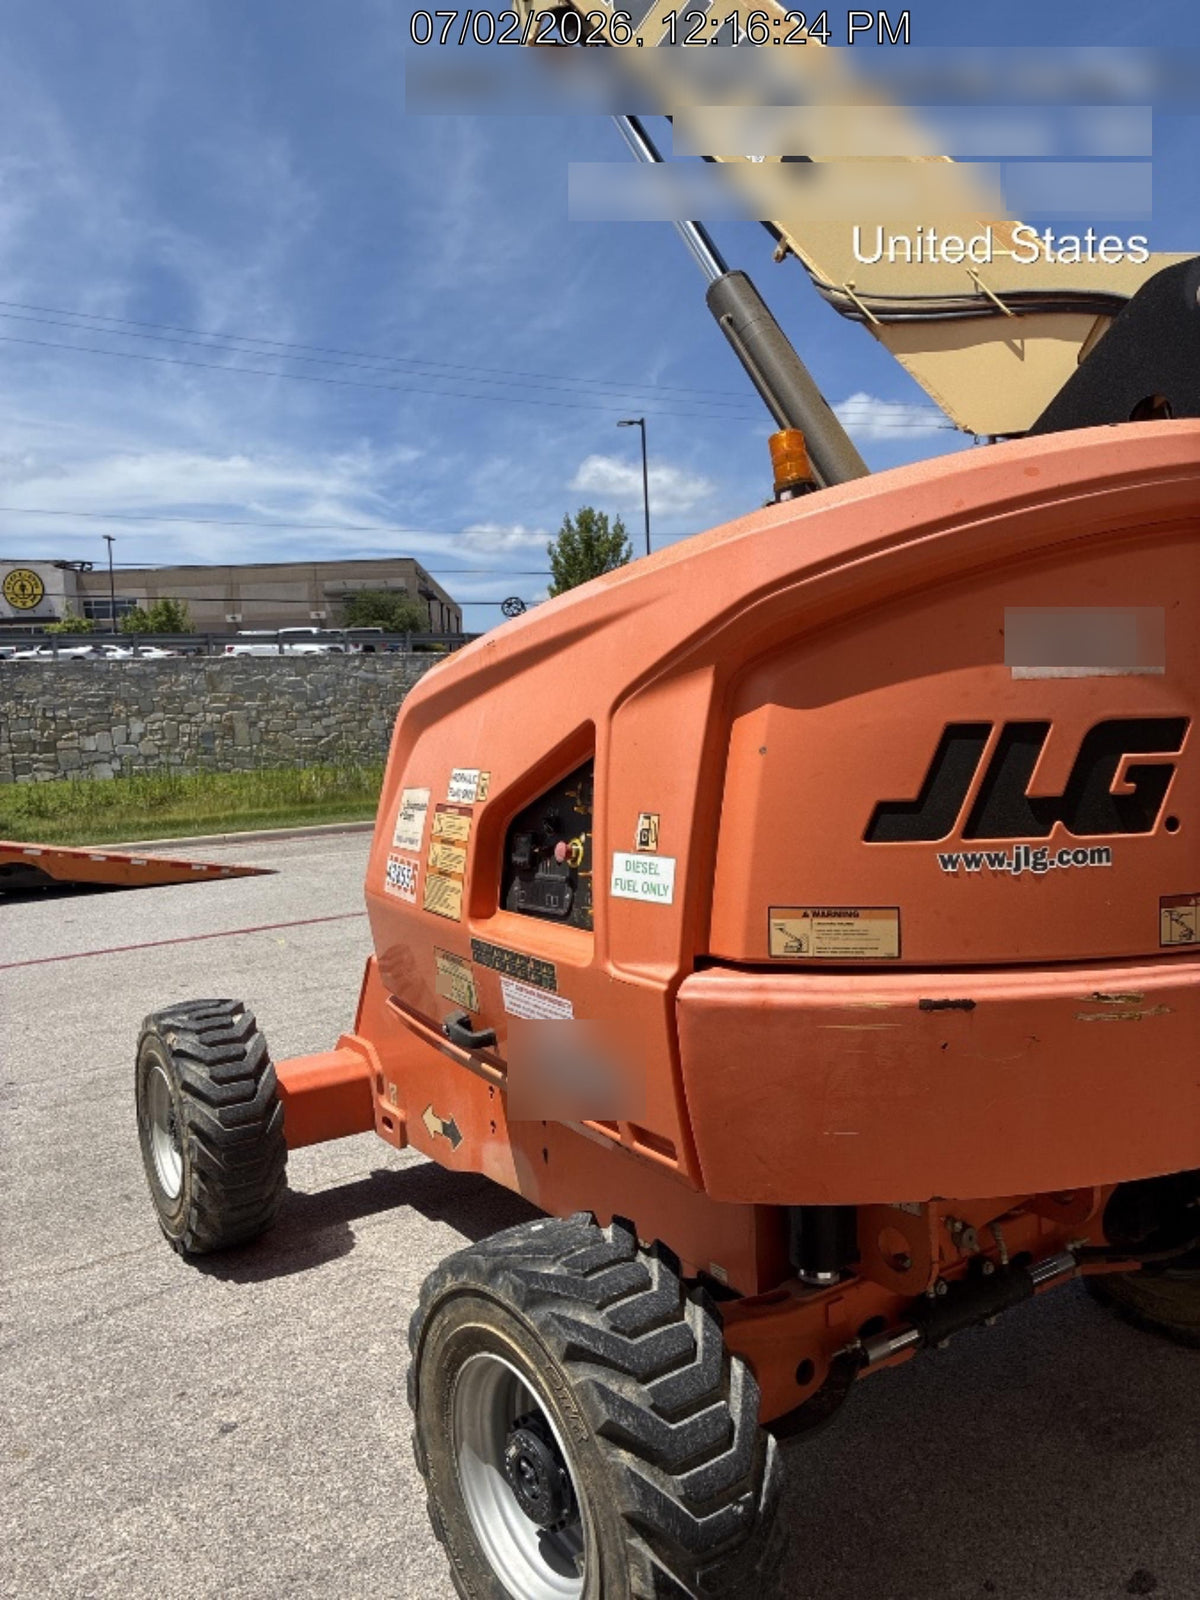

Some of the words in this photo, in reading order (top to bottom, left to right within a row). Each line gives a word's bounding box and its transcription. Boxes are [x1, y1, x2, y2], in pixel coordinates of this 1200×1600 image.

[625, 859, 661, 876] DIESEL
[937, 844, 1113, 876] www.jlg.com
[614, 877, 639, 894] FUEL
[641, 881, 670, 897] ONLY
